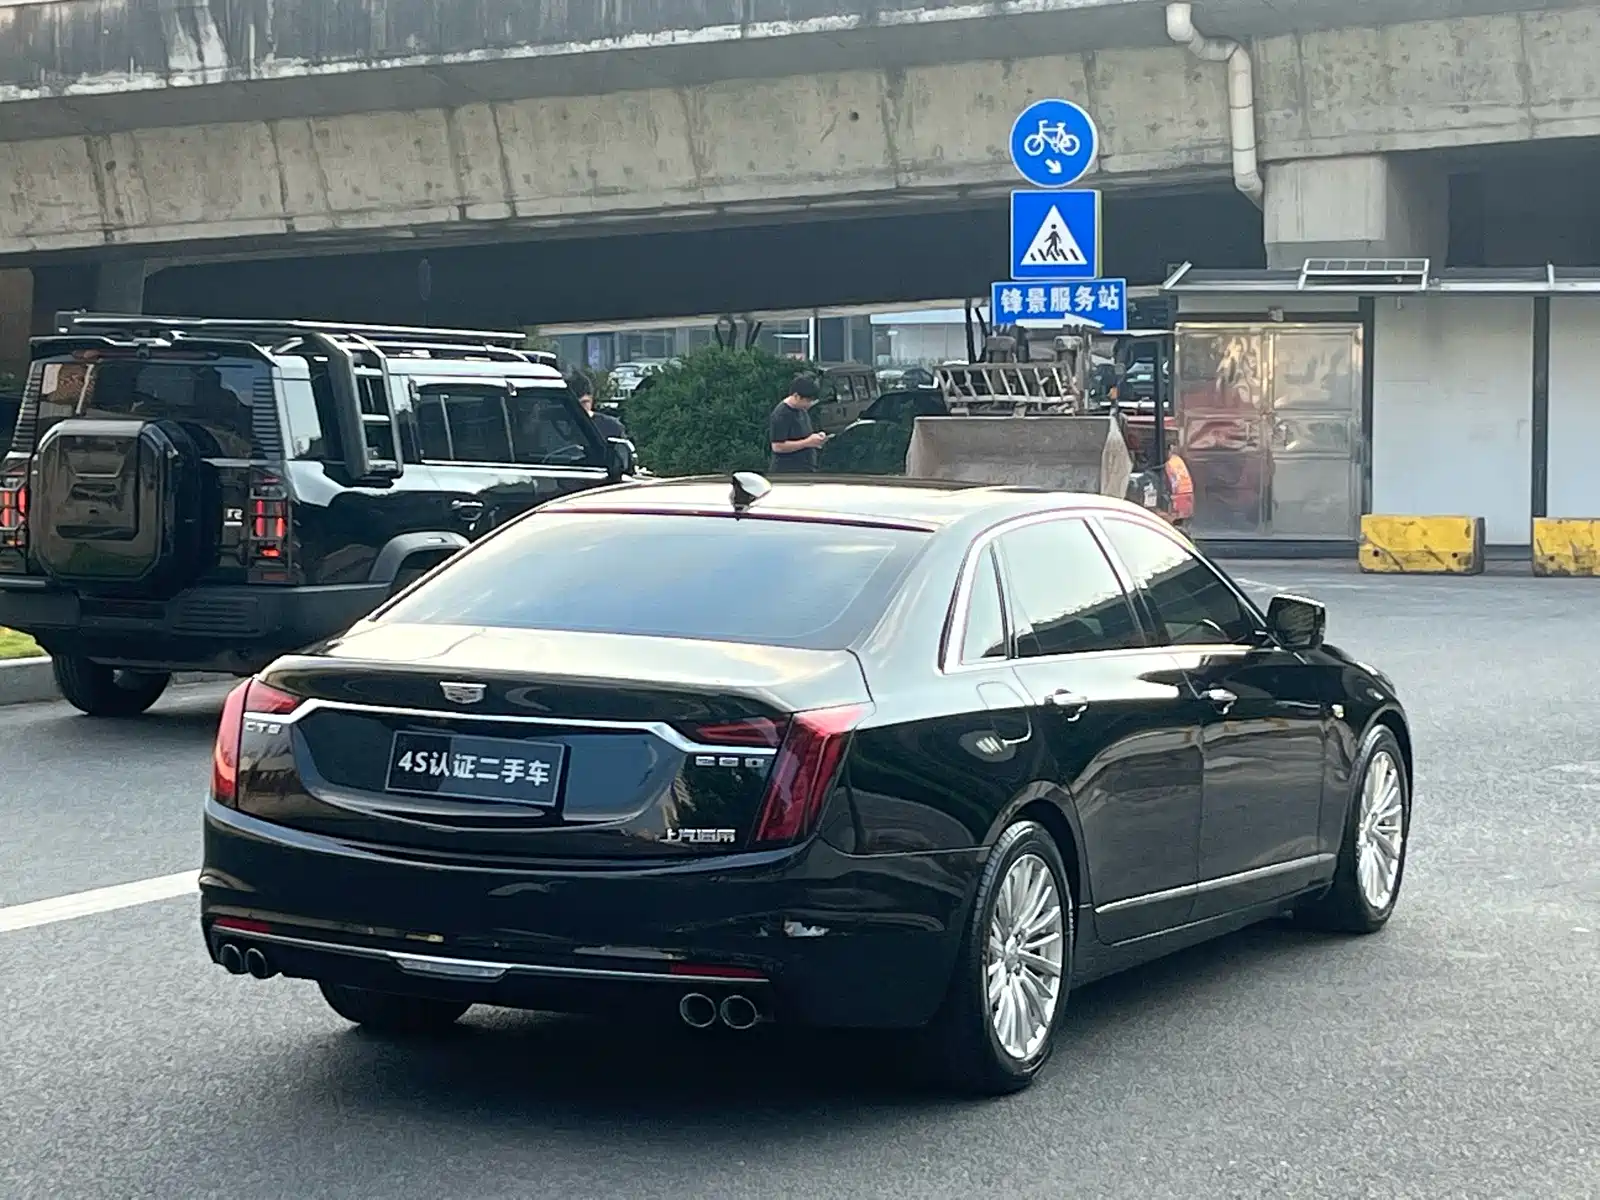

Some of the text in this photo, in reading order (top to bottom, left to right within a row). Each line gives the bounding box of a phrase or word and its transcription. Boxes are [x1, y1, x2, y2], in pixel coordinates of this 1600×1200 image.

[1000, 284, 1120, 315] 锋景服务站
[398, 751, 551, 787] 4S认证二手车
